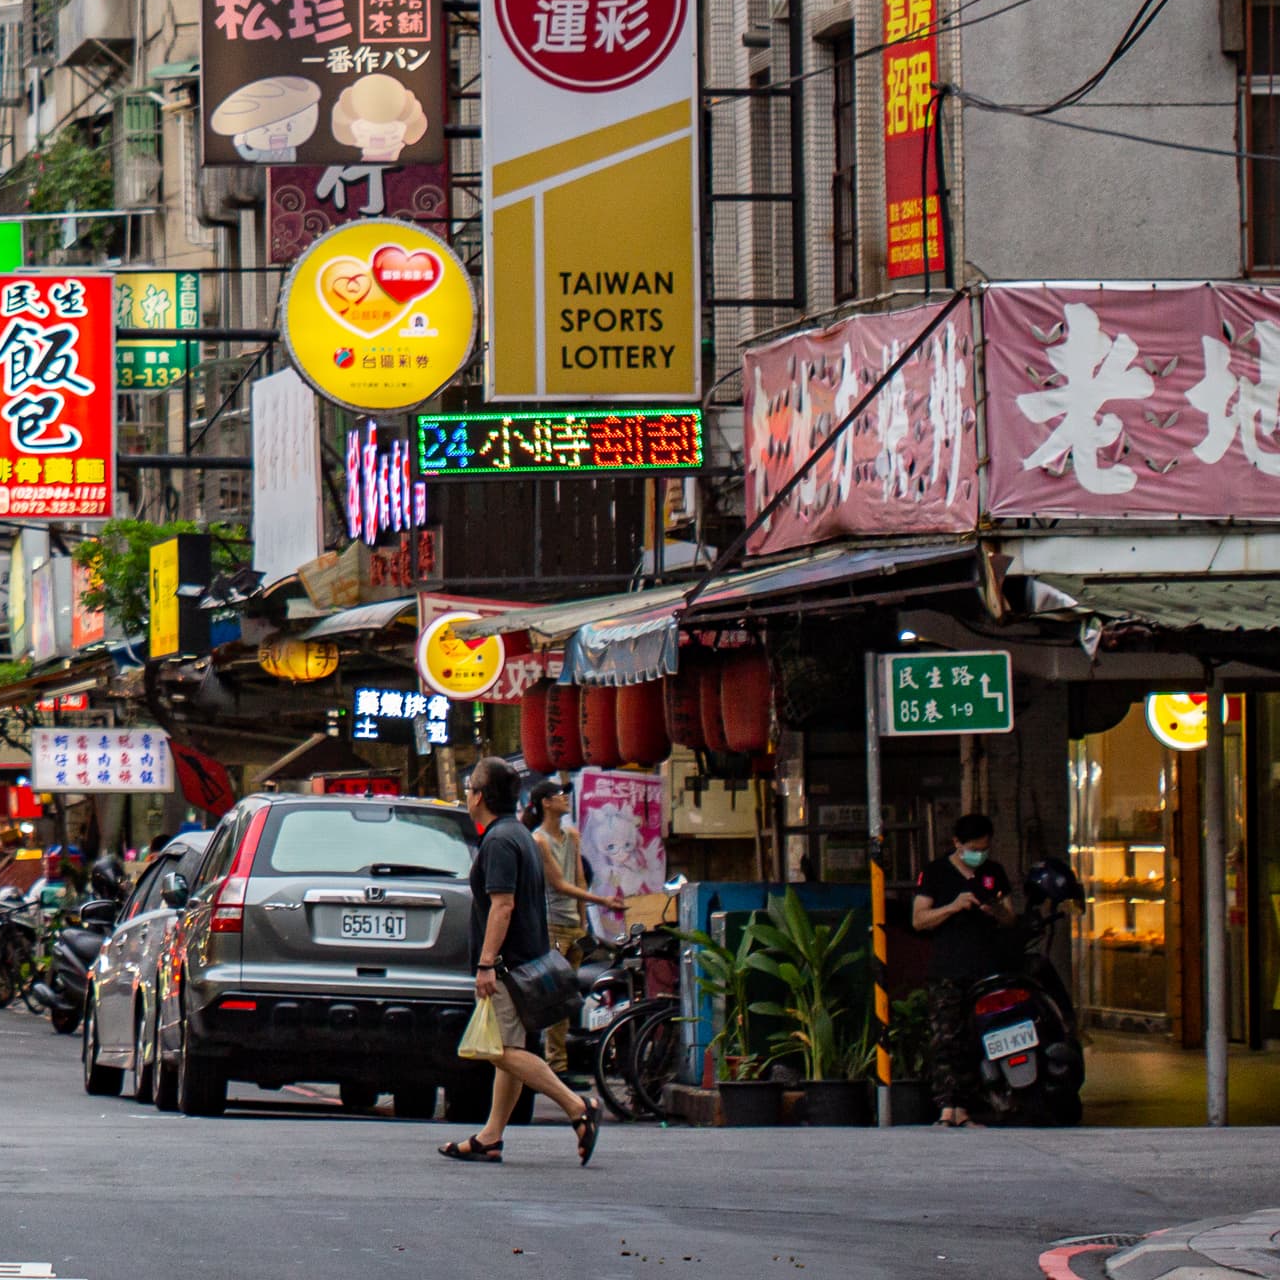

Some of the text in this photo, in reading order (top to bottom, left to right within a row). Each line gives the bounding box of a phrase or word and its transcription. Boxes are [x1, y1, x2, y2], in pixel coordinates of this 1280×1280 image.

[533, 0, 651, 56] 運彩
[560, 272, 675, 296] TAIWAN
[5, 281, 89, 317] 民生
[560, 308, 664, 333] SPORTS
[561, 345, 677, 369] LOTTERY
[899, 666, 975, 689] 民生路
[951, 702, 974, 717] 1-9
